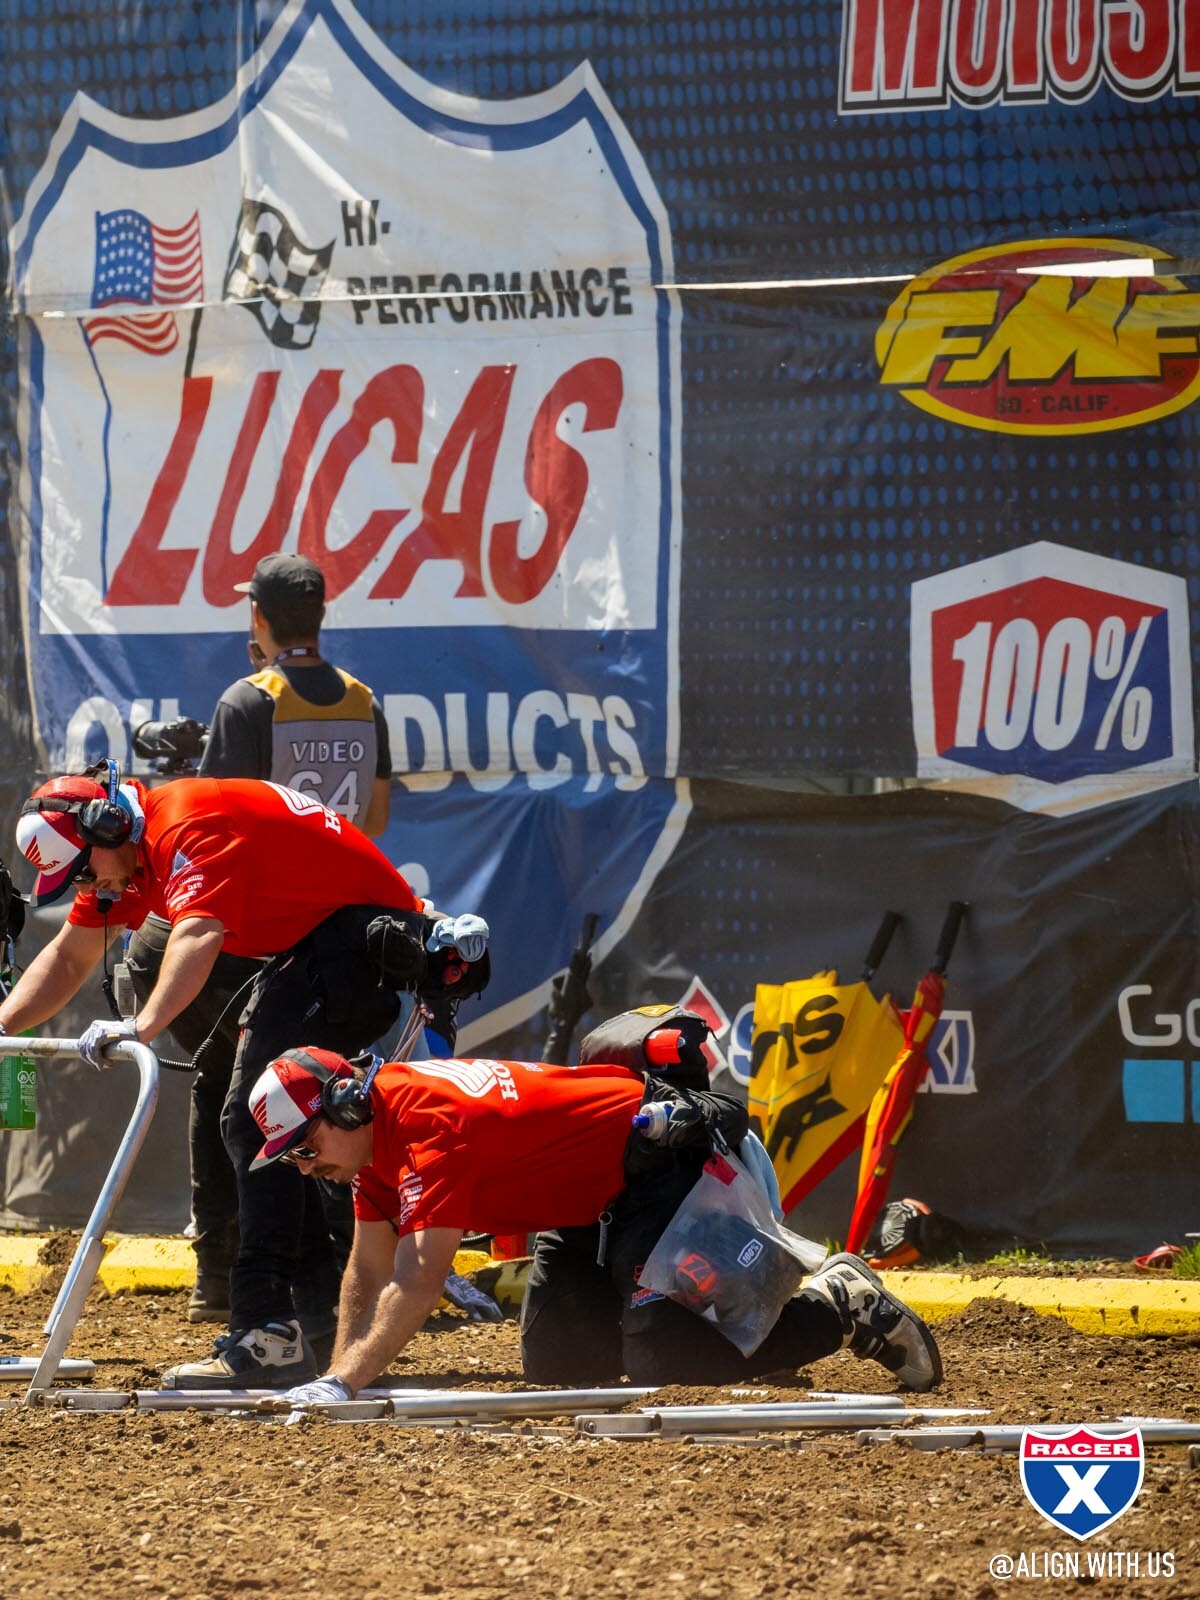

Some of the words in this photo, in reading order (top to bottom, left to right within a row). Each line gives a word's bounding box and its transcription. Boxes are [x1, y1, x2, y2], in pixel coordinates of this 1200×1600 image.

[340, 199, 391, 247] HI-
[346, 266, 634, 326] PERFORMANCE
[880, 272, 1200, 387] FMF
[1041, 394, 1119, 413] CALIF.
[103, 356, 624, 607] LUCAS
[952, 616, 1153, 752] 100%
[290, 740, 366, 763] VIDEO
[383, 690, 649, 793] DUCTS
[286, 768, 362, 827] 64
[262, 1123, 285, 1137] NDA
[741, 1242, 760, 1264] 100%
